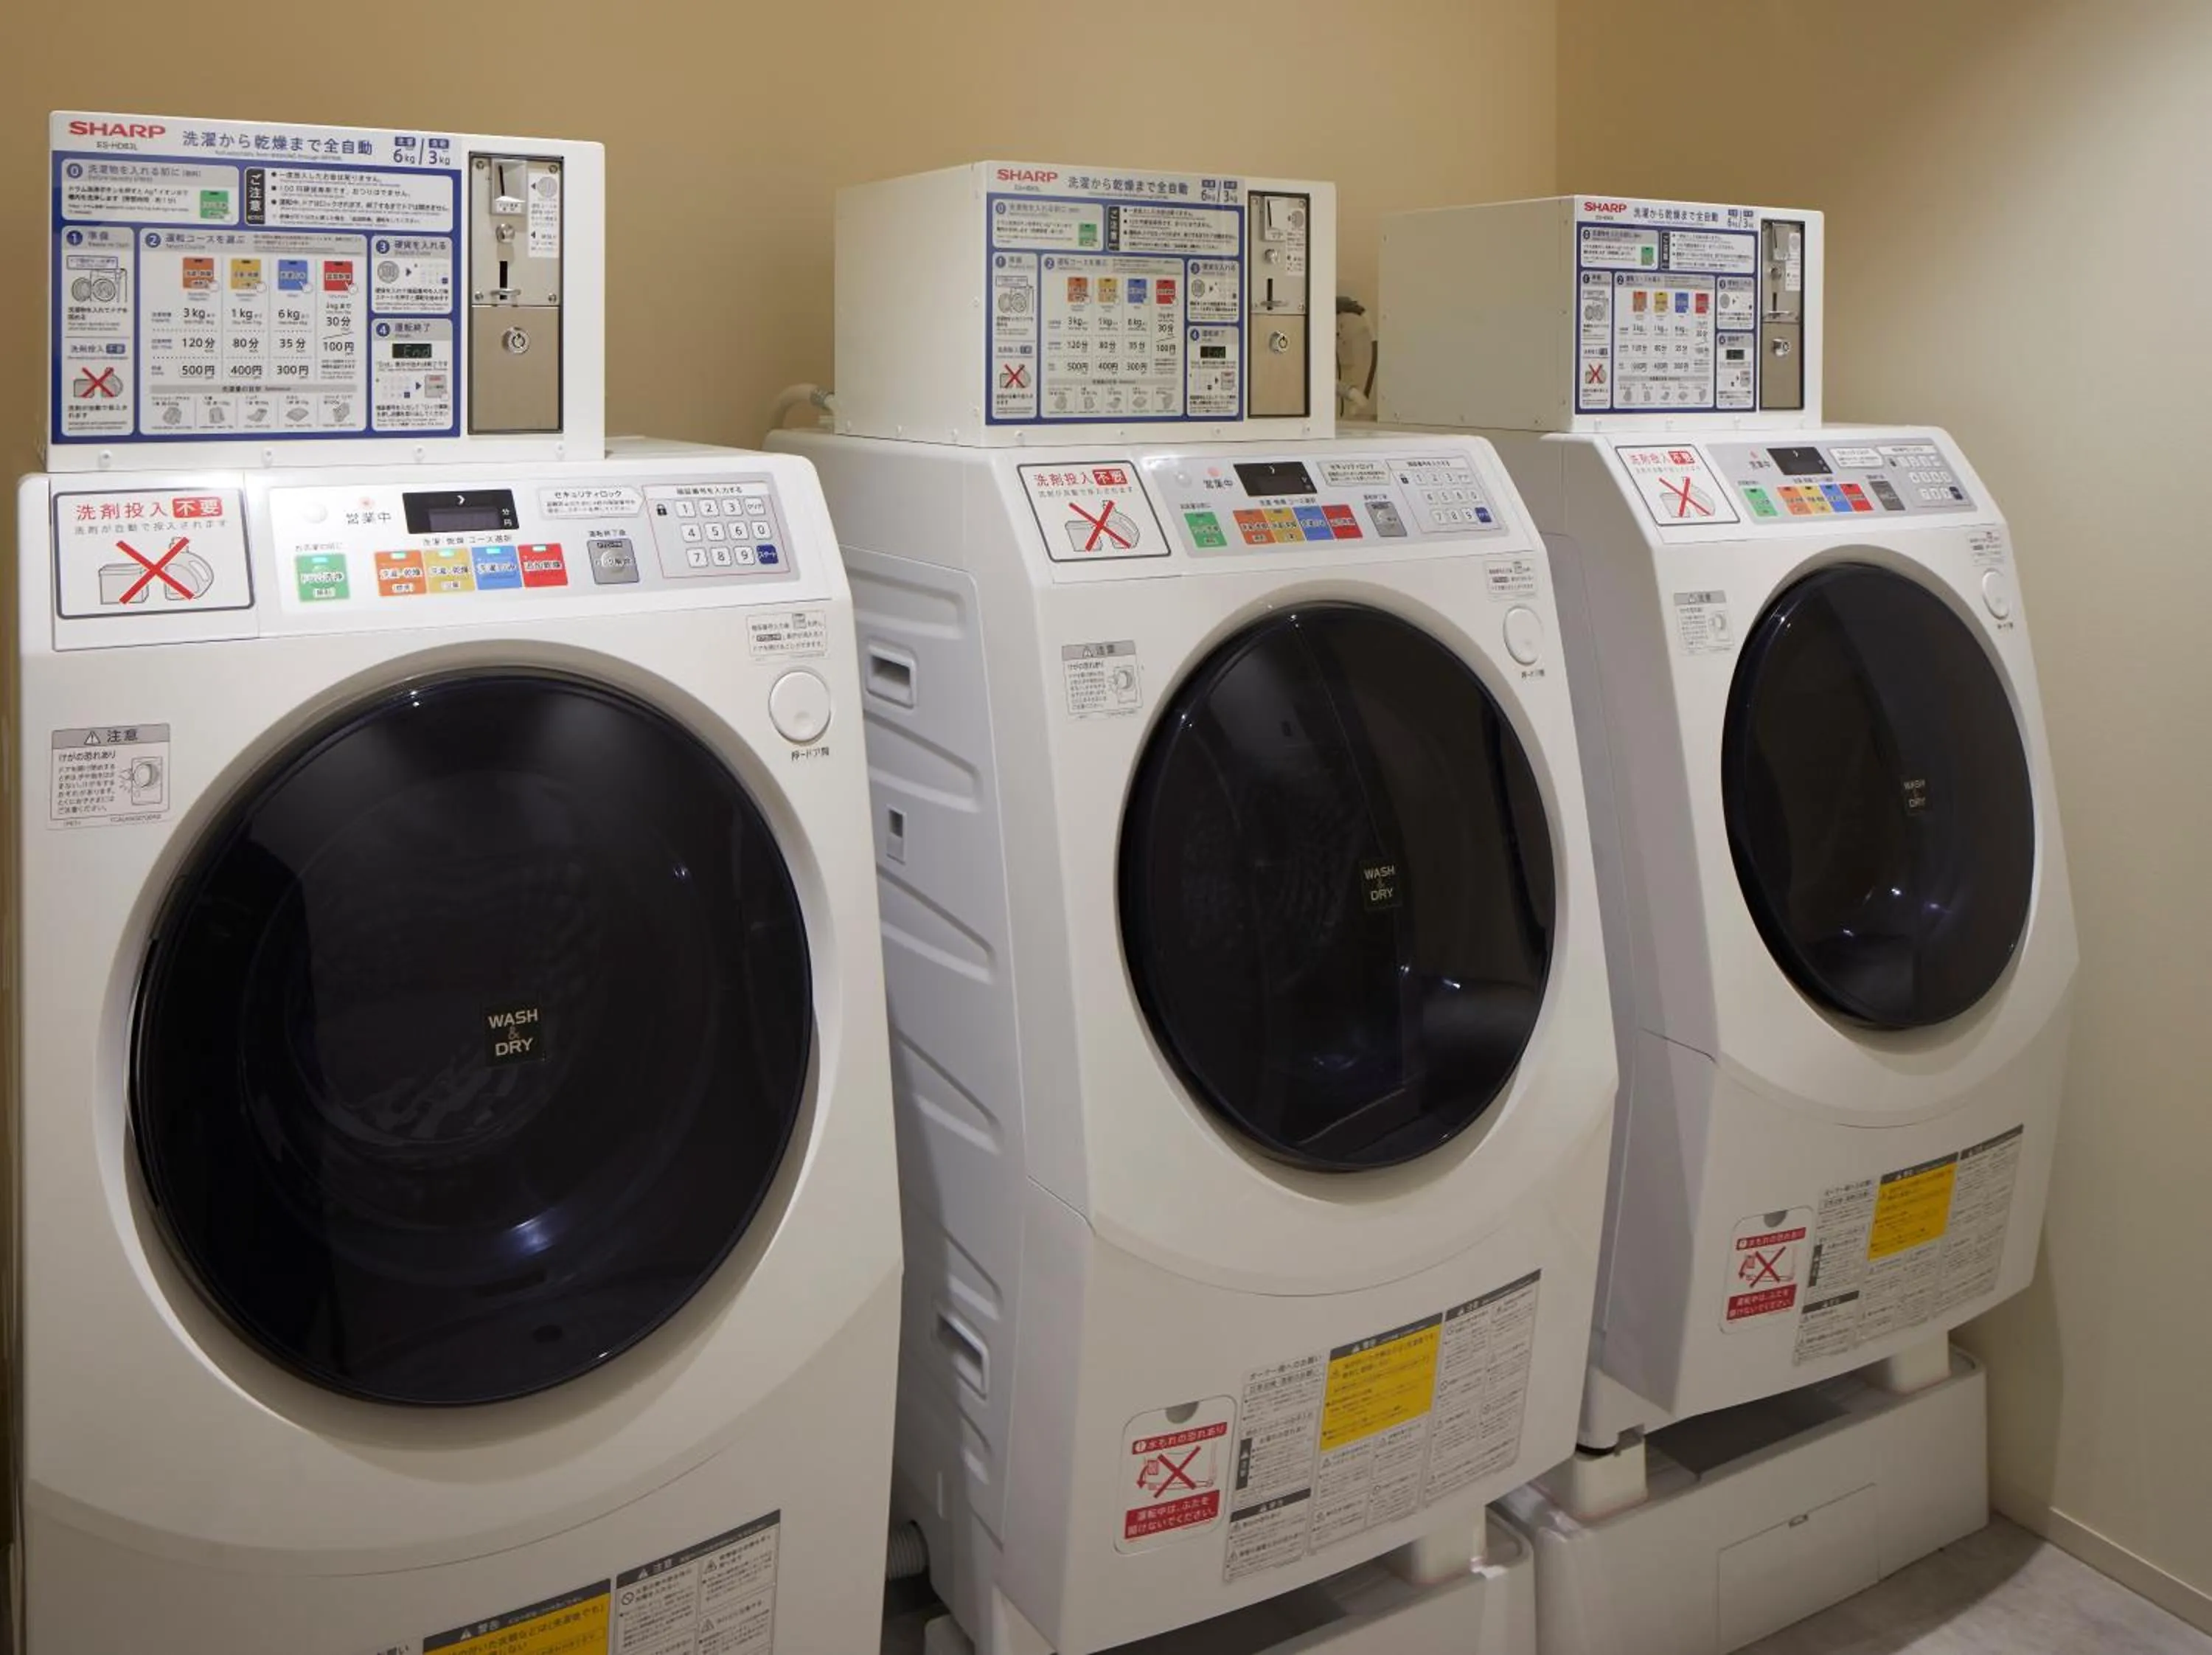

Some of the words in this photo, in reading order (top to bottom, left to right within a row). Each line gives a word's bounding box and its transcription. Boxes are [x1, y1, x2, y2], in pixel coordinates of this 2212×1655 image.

[69, 121, 166, 139] SHARP
[182, 131, 372, 155] 洗濯から乾燥まで全自動
[997, 169, 1058, 183] SHARP
[1067, 176, 1189, 196] 洗濯から乾燥まで全自動
[1585, 202, 1627, 213] SHARP
[554, 490, 622, 499] セキュリティロック
[75, 502, 168, 521] 洗剤投入
[175, 499, 221, 517] 不要
[74, 519, 229, 535] 洗剤が自動で投入されます
[106, 729, 138, 743] 注意
[58, 750, 116, 762] けがの恐れあり
[1363, 864, 1395, 880] WASH
[1371, 888, 1393, 901] DRY
[488, 1008, 538, 1029] WASH
[495, 1037, 533, 1056] DRY
